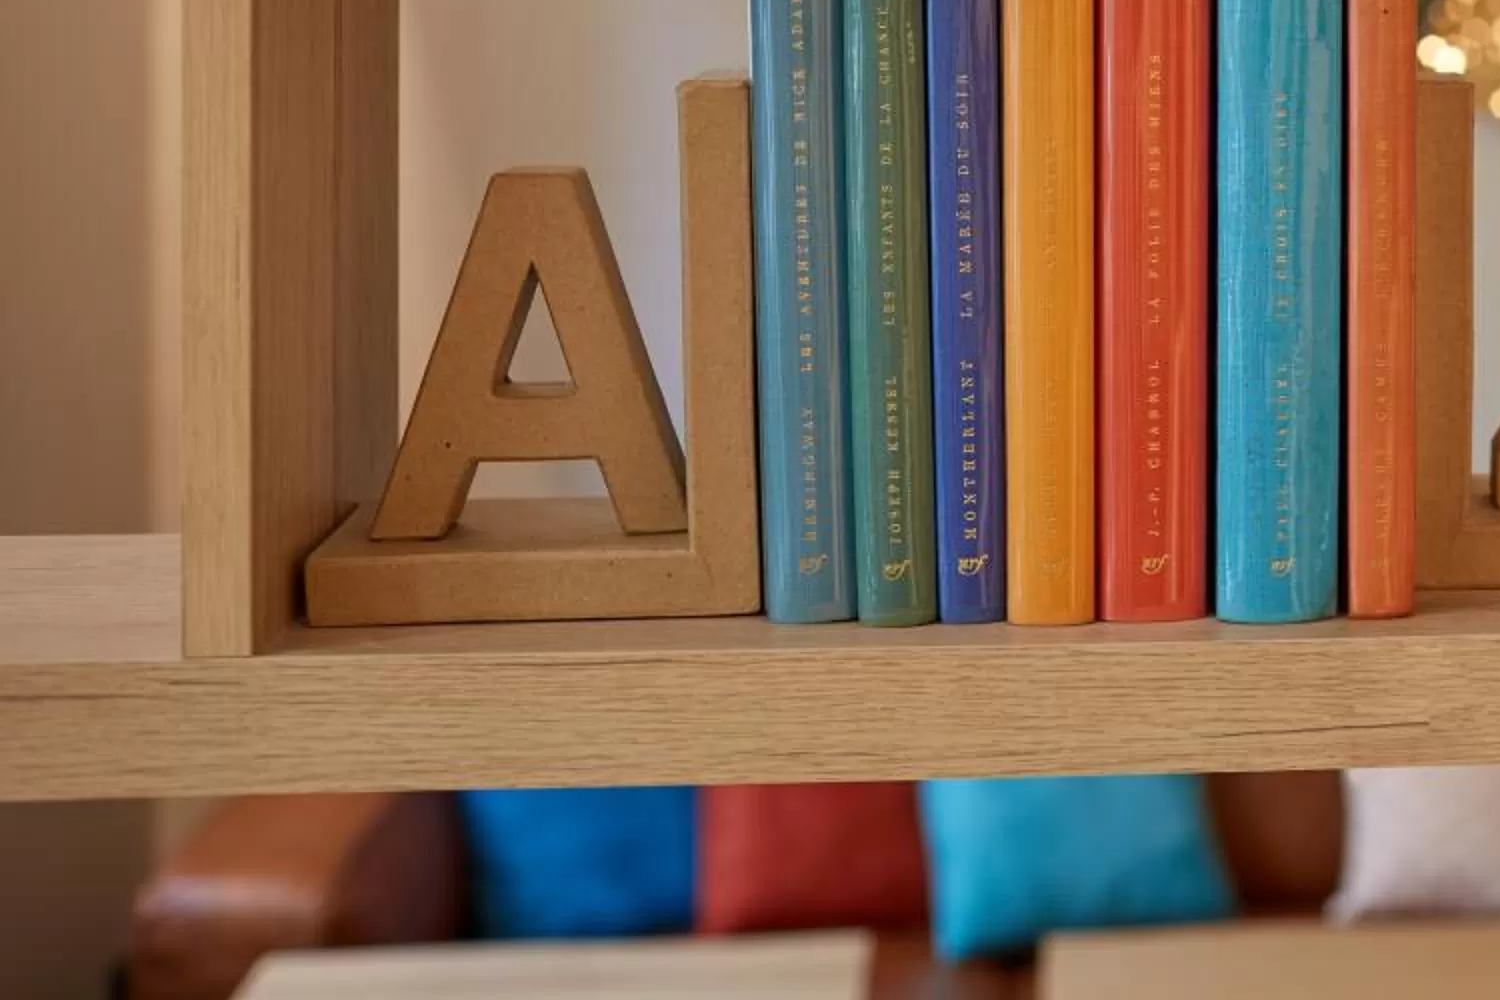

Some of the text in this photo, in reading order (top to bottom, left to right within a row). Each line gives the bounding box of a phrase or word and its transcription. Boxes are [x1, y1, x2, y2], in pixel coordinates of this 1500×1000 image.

[956, 73, 971, 131] SOIR
[957, 148, 970, 177] DU
[877, 7, 904, 545] JOSEPH KESSEL LES ENFANTS DE LA CHANCE
[961, 291, 974, 318] LA
[1147, 297, 1161, 324] LA
[368, 165, 687, 541] A
[961, 361, 978, 540] MONTHERLANT
[1147, 361, 1161, 469] CHABROL
[802, 408, 817, 541] HEMINGWAY
